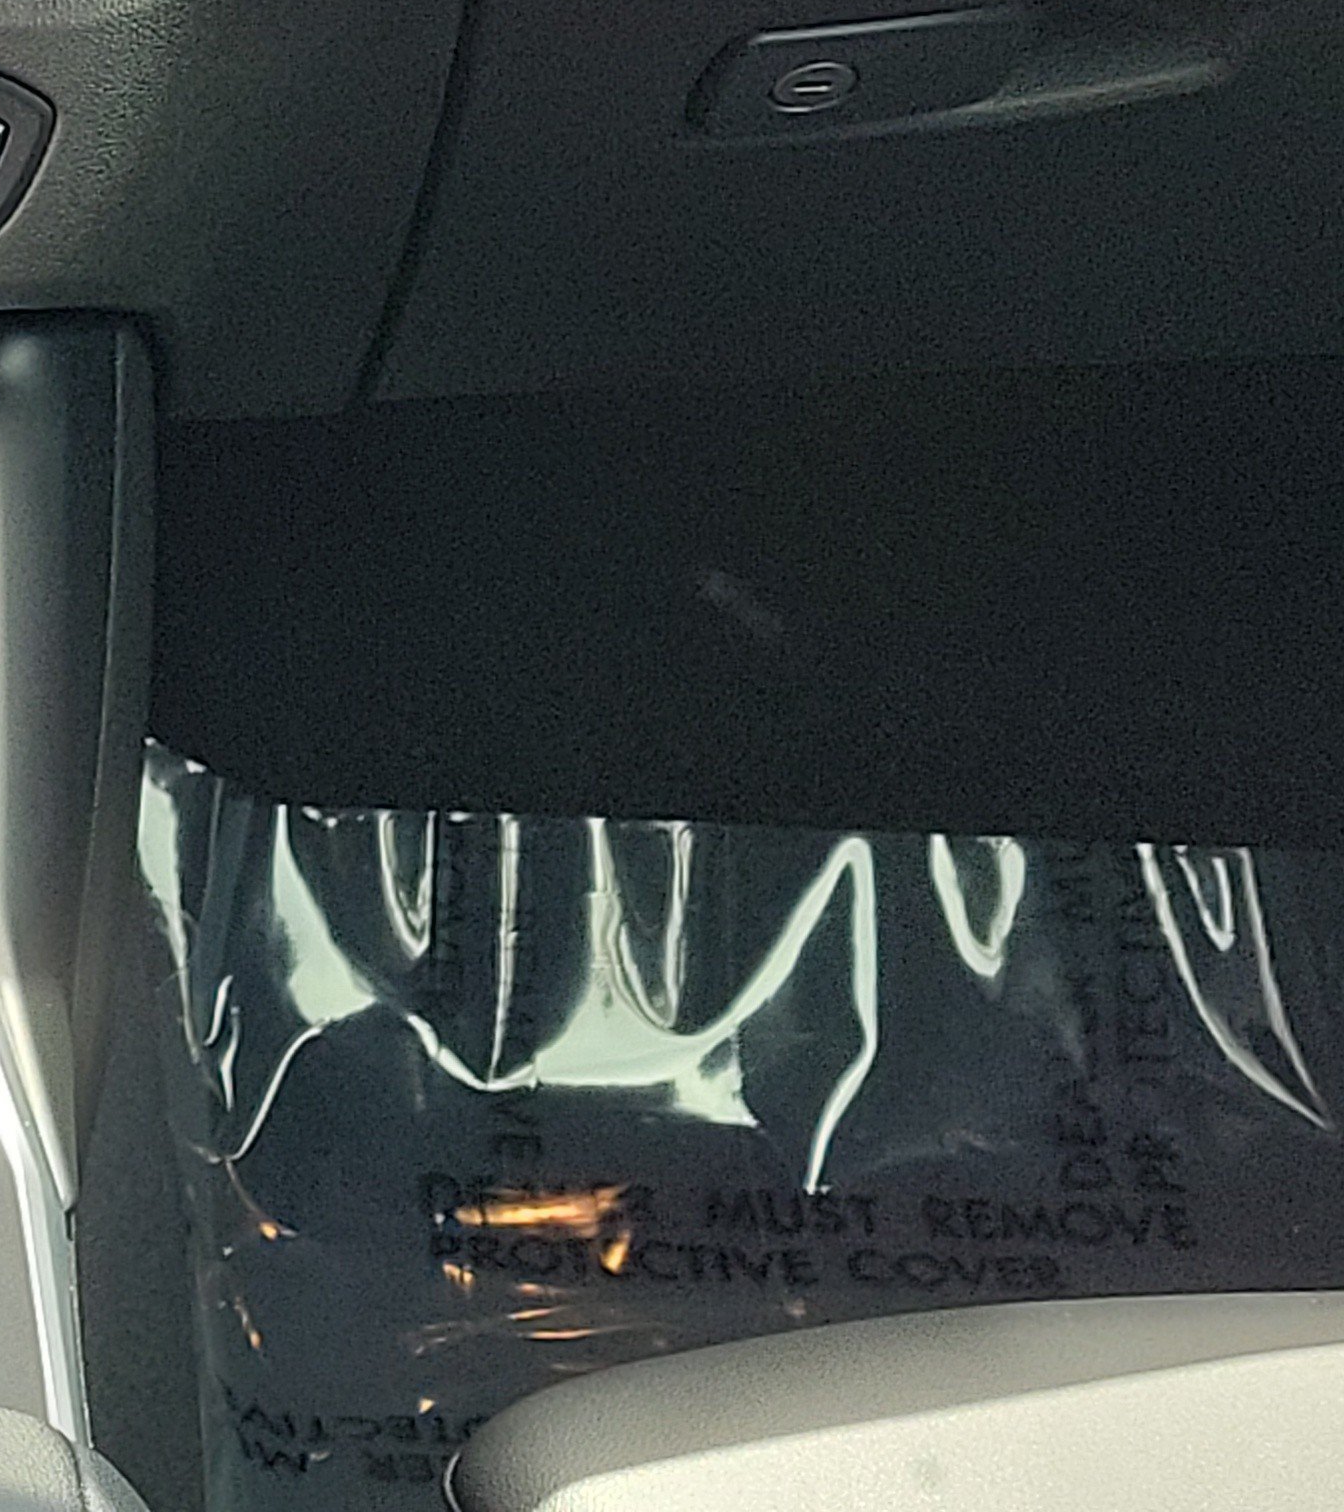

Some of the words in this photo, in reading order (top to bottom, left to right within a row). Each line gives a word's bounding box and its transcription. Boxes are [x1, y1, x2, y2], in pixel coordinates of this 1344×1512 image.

[705, 1189, 879, 1236] MUST
[920, 1193, 1199, 1249] REMOVE
[846, 1248, 1066, 1291] COVER
